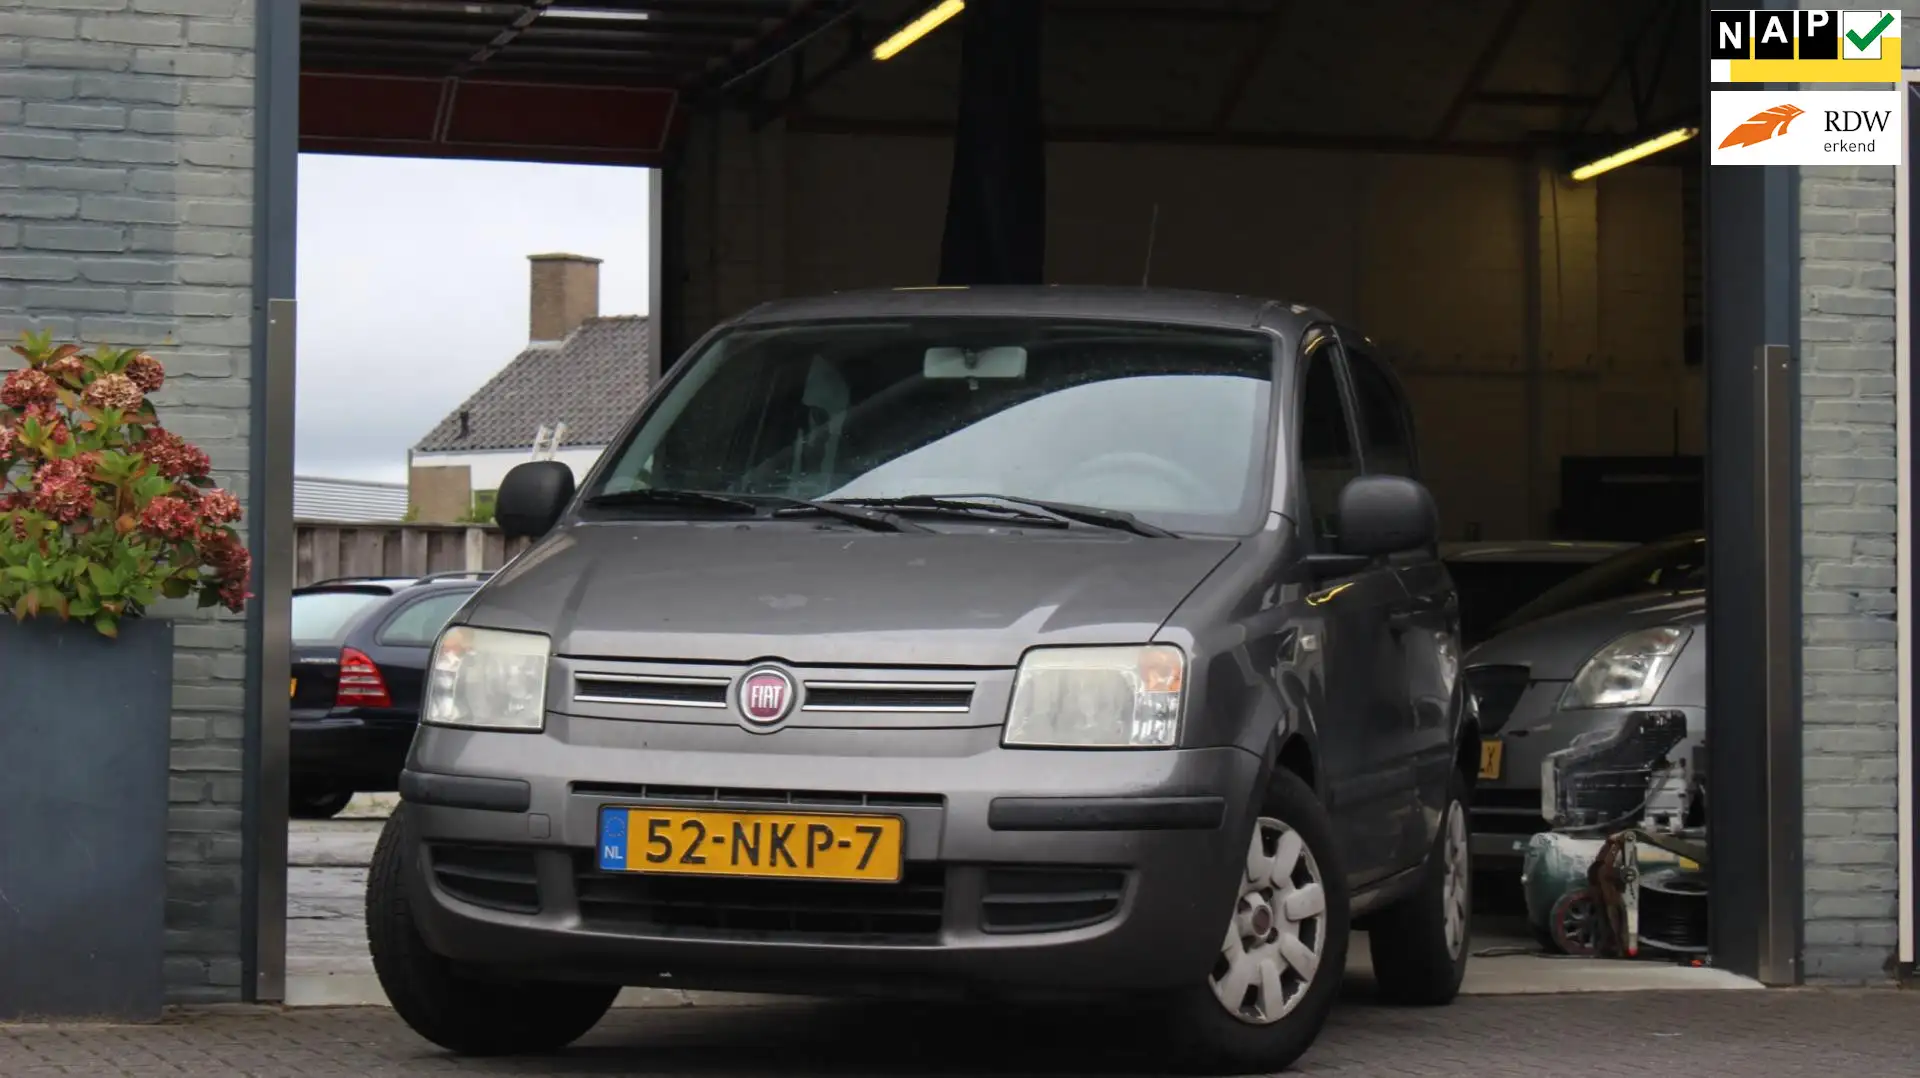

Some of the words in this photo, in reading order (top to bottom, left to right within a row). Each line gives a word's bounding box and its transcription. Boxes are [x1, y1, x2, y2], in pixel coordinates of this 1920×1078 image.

[751, 685, 783, 709] FIAT
[604, 845, 623, 859] NL
[645, 818, 884, 871] 52-NKP-7
